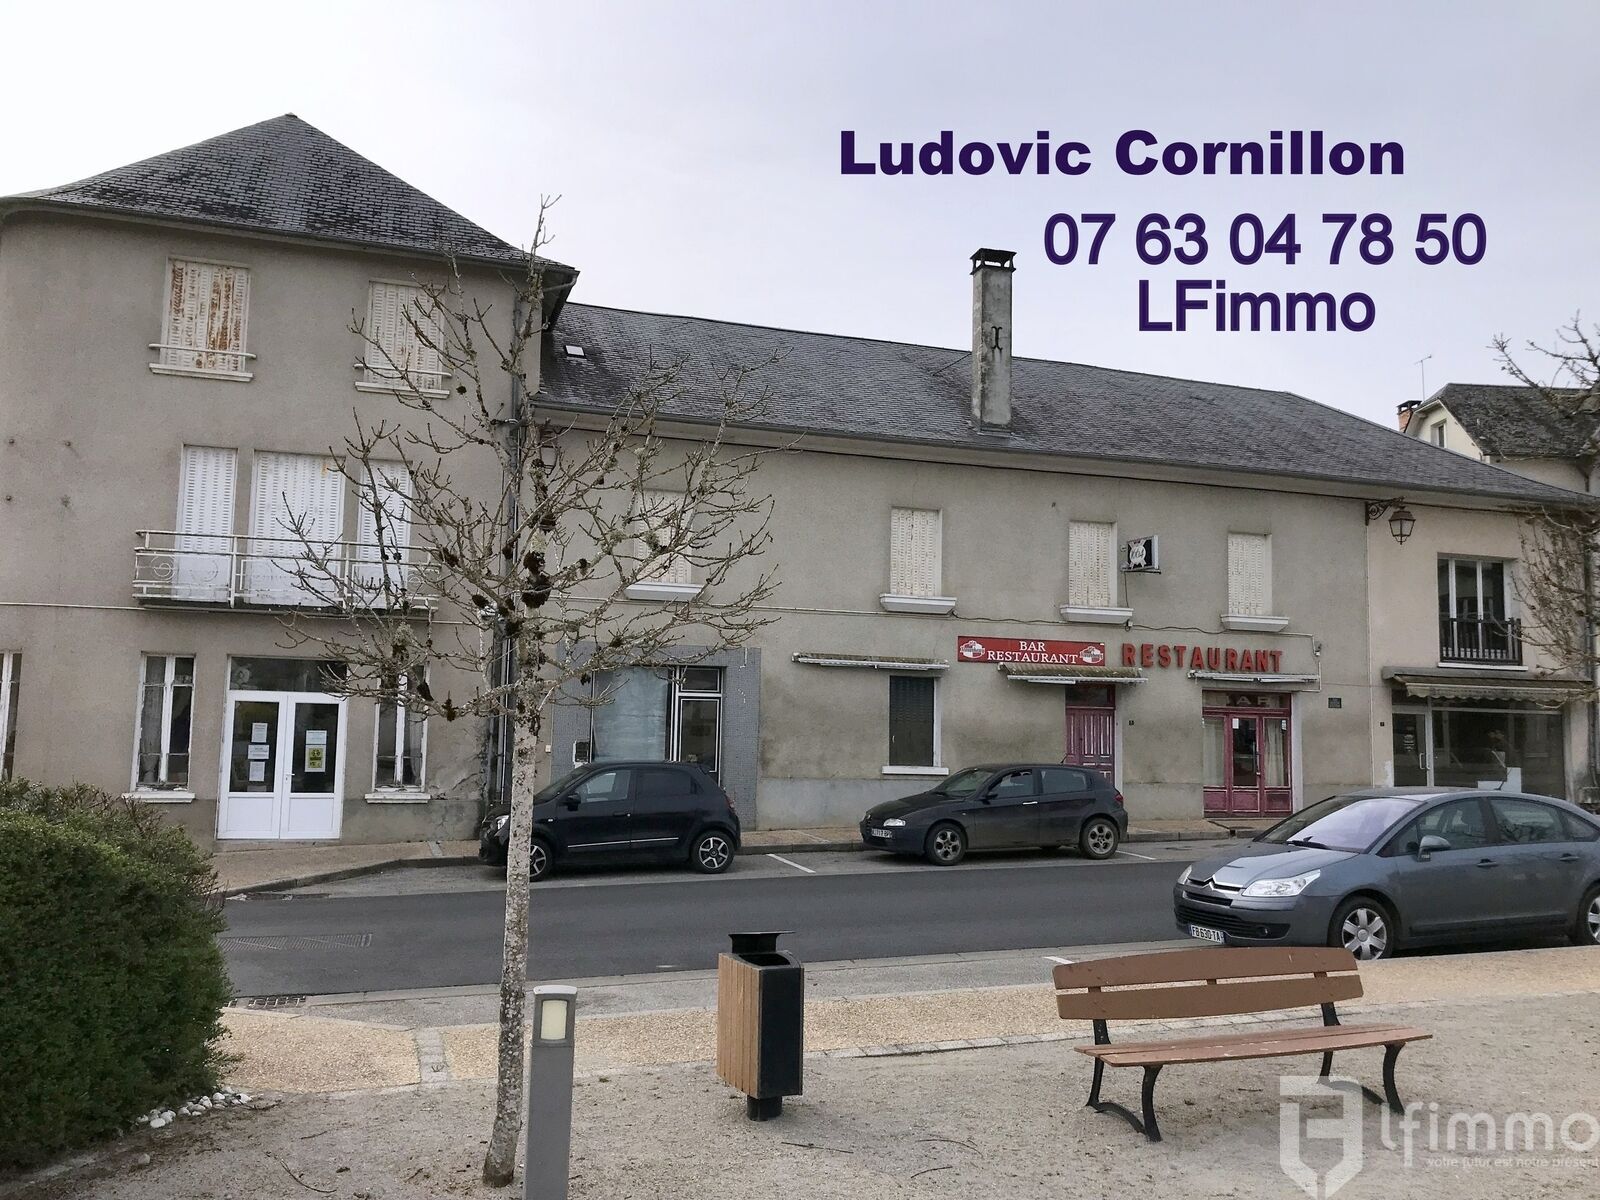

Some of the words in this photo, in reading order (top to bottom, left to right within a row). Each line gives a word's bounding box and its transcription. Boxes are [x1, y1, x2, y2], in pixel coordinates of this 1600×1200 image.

[1019, 640, 1046, 652] BAR
[987, 650, 1079, 664] RESTAURANT
[1122, 643, 1283, 672] RESTAURANT
